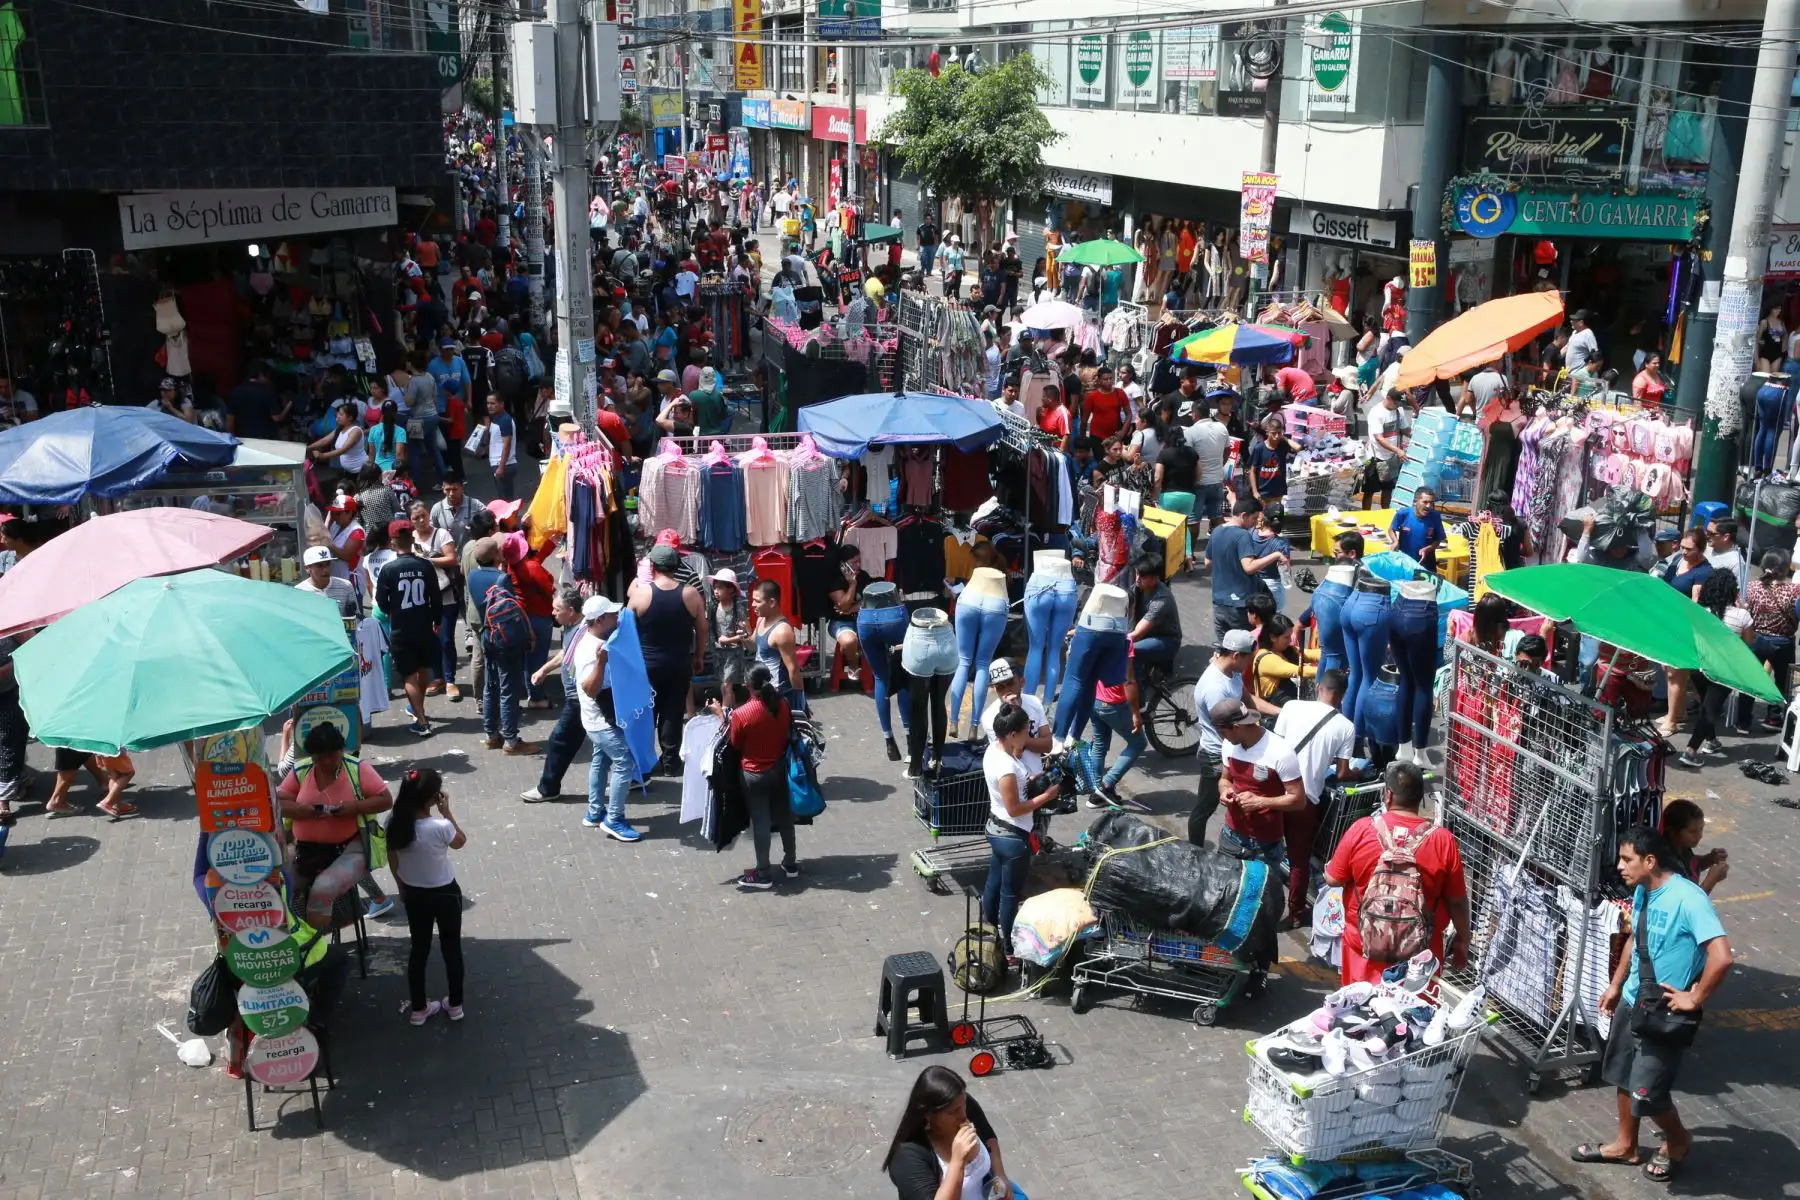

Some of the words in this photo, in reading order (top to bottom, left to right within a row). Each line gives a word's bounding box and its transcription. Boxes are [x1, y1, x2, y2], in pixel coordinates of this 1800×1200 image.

[1313, 48, 1350, 61] GAMARRA
[1048, 168, 1099, 193] Ricaldi
[1242, 174, 1260, 184] SANTA
[128, 204, 158, 234] La
[167, 199, 263, 238] Séptima
[271, 193, 302, 222] de
[310, 191, 391, 219] Gamarra
[1522, 200, 1594, 225] CENTRO
[1598, 203, 1690, 227] GAMARRA
[1313, 212, 1369, 241] Gissett
[840, 272, 860, 280] POLOS
[472, 362, 479, 380] 7
[398, 579, 426, 610] 20
[212, 779, 233, 789] VIVE
[235, 777, 248, 786] LO
[222, 838, 256, 853] TODO
[216, 847, 266, 862] ILIMITADO
[224, 888, 264, 900] Claro
[233, 900, 273, 910] recarga
[233, 950, 294, 962] RECARGAS
[236, 957, 295, 969] MOVISTAR
[242, 995, 303, 1011] ILIMITADO
[256, 1036, 297, 1050] Claro
[266, 1045, 305, 1059] recarga
